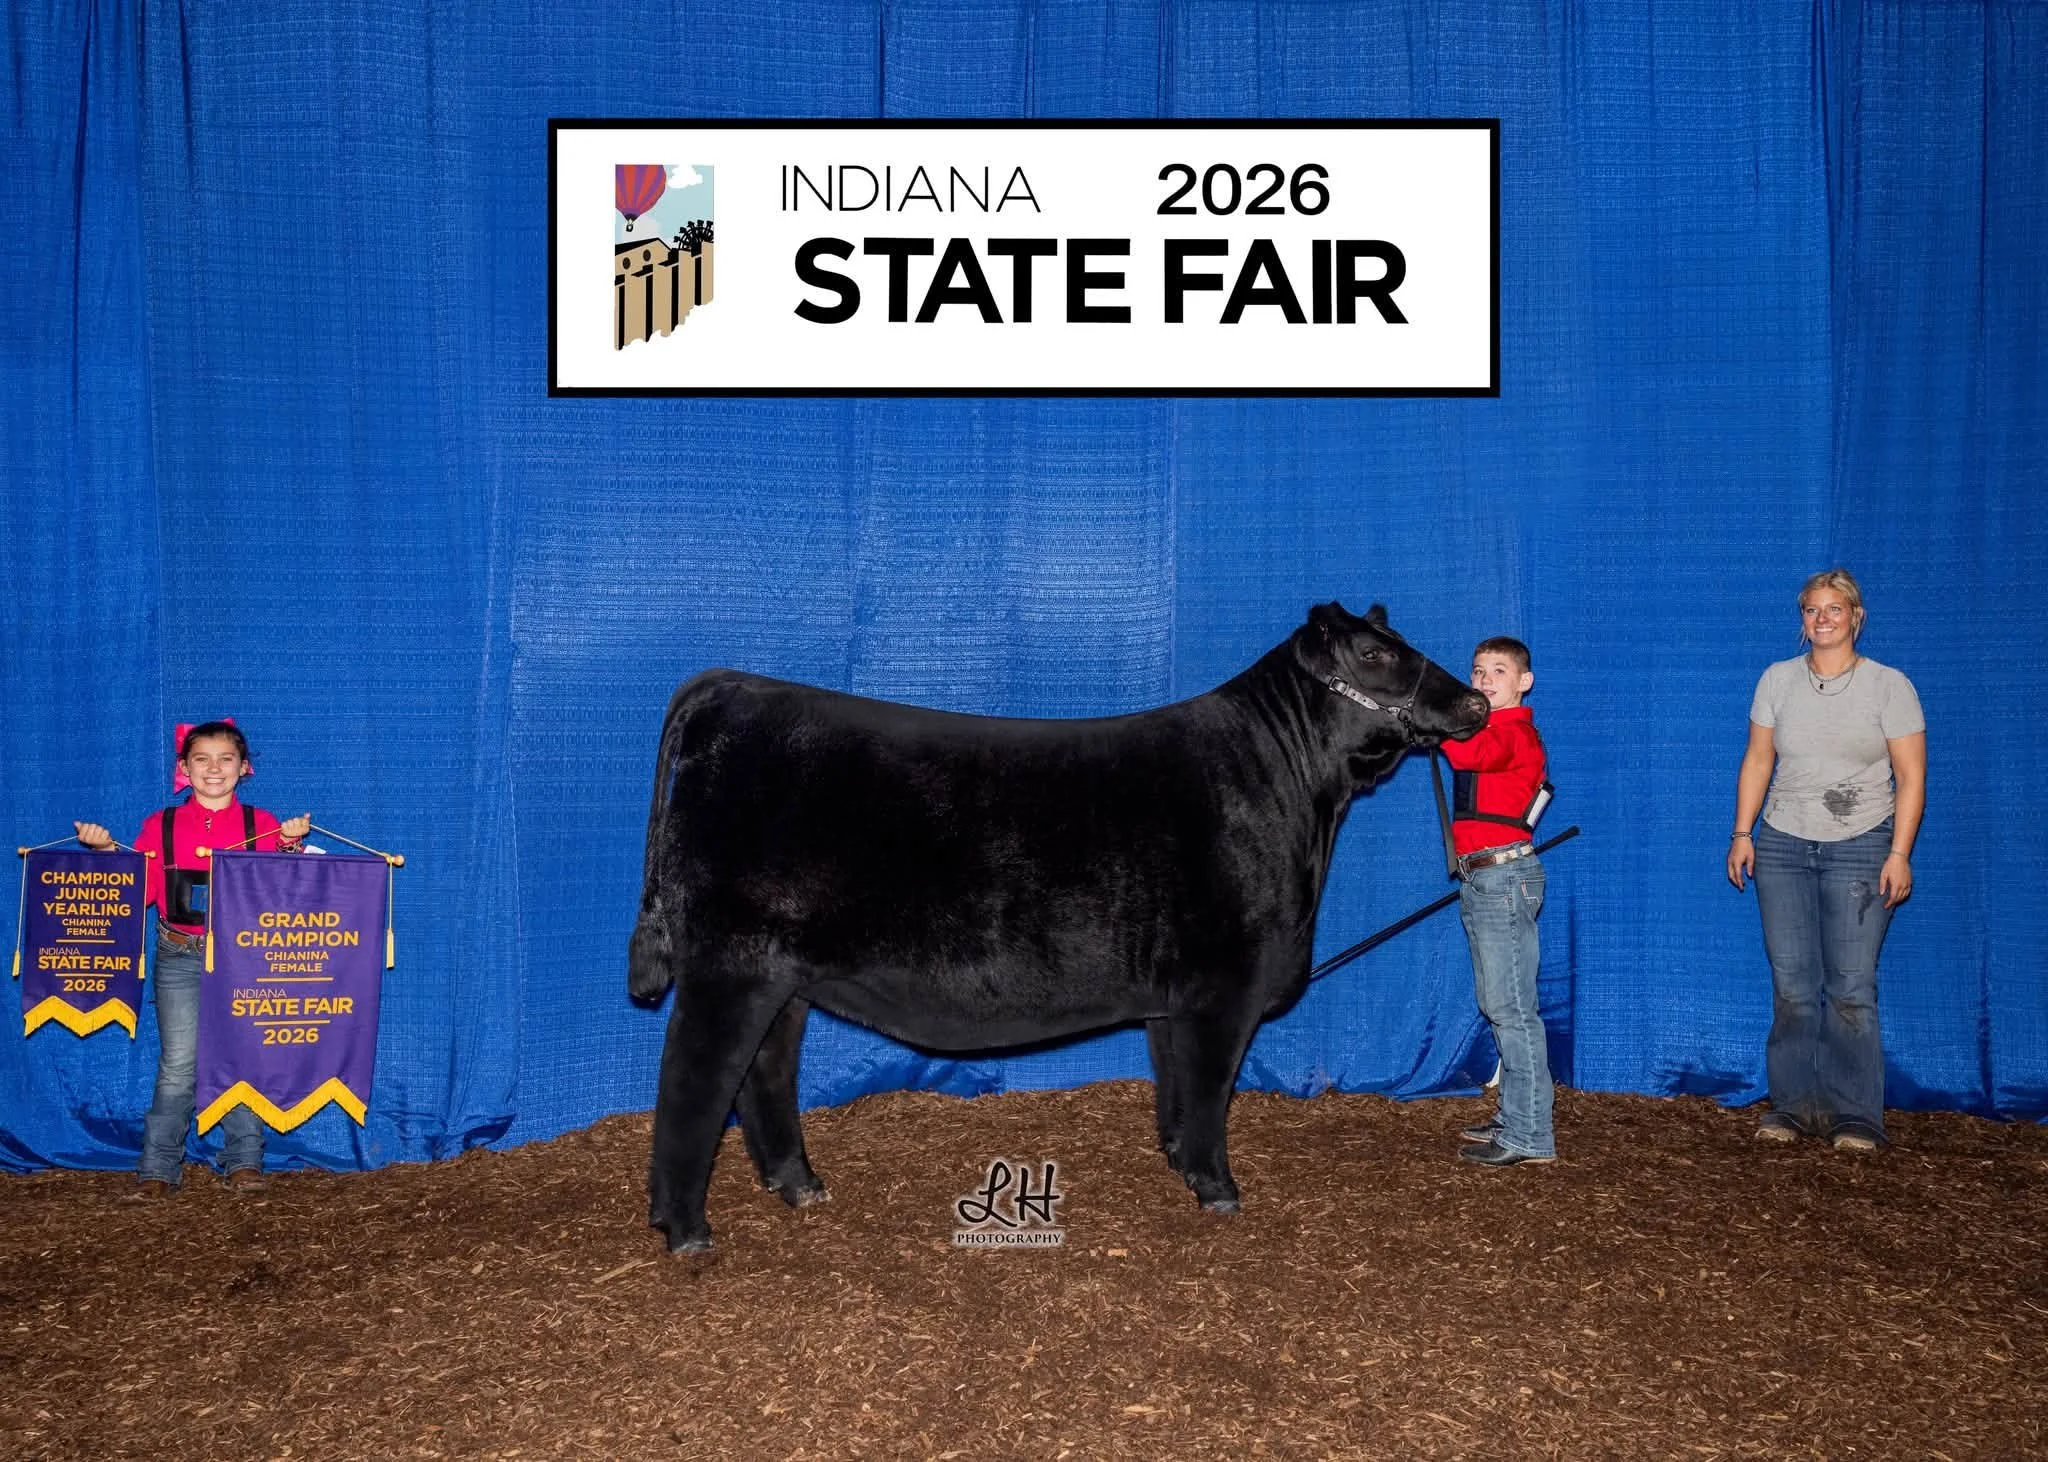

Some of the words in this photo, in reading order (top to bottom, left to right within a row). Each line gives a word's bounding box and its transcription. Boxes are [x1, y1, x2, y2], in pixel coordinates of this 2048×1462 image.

[782, 164, 1041, 212] INDIANA
[1157, 163, 1330, 216] 2026
[794, 237, 1131, 325] STATE
[1165, 238, 1409, 325] FAIR
[41, 871, 135, 886] CHAMPION
[55, 887, 120, 901] JUNIOR
[43, 902, 131, 917] YEARLING
[62, 918, 112, 927] CHIANINA
[259, 911, 340, 929] GRAND
[66, 928, 107, 937] FEMALE
[236, 931, 359, 947] CHAMPION
[38, 947, 81, 956] INDIANA
[264, 950, 329, 961] CHIANINA
[38, 955, 90, 970] STATE
[93, 955, 131, 970] FAIR
[270, 962, 323, 973] FEMALE
[63, 978, 106, 992] 2026
[232, 988, 288, 999] INDIANA
[231, 997, 299, 1016] STATE
[303, 997, 353, 1015] FAIR
[262, 1027, 319, 1044] 2026
